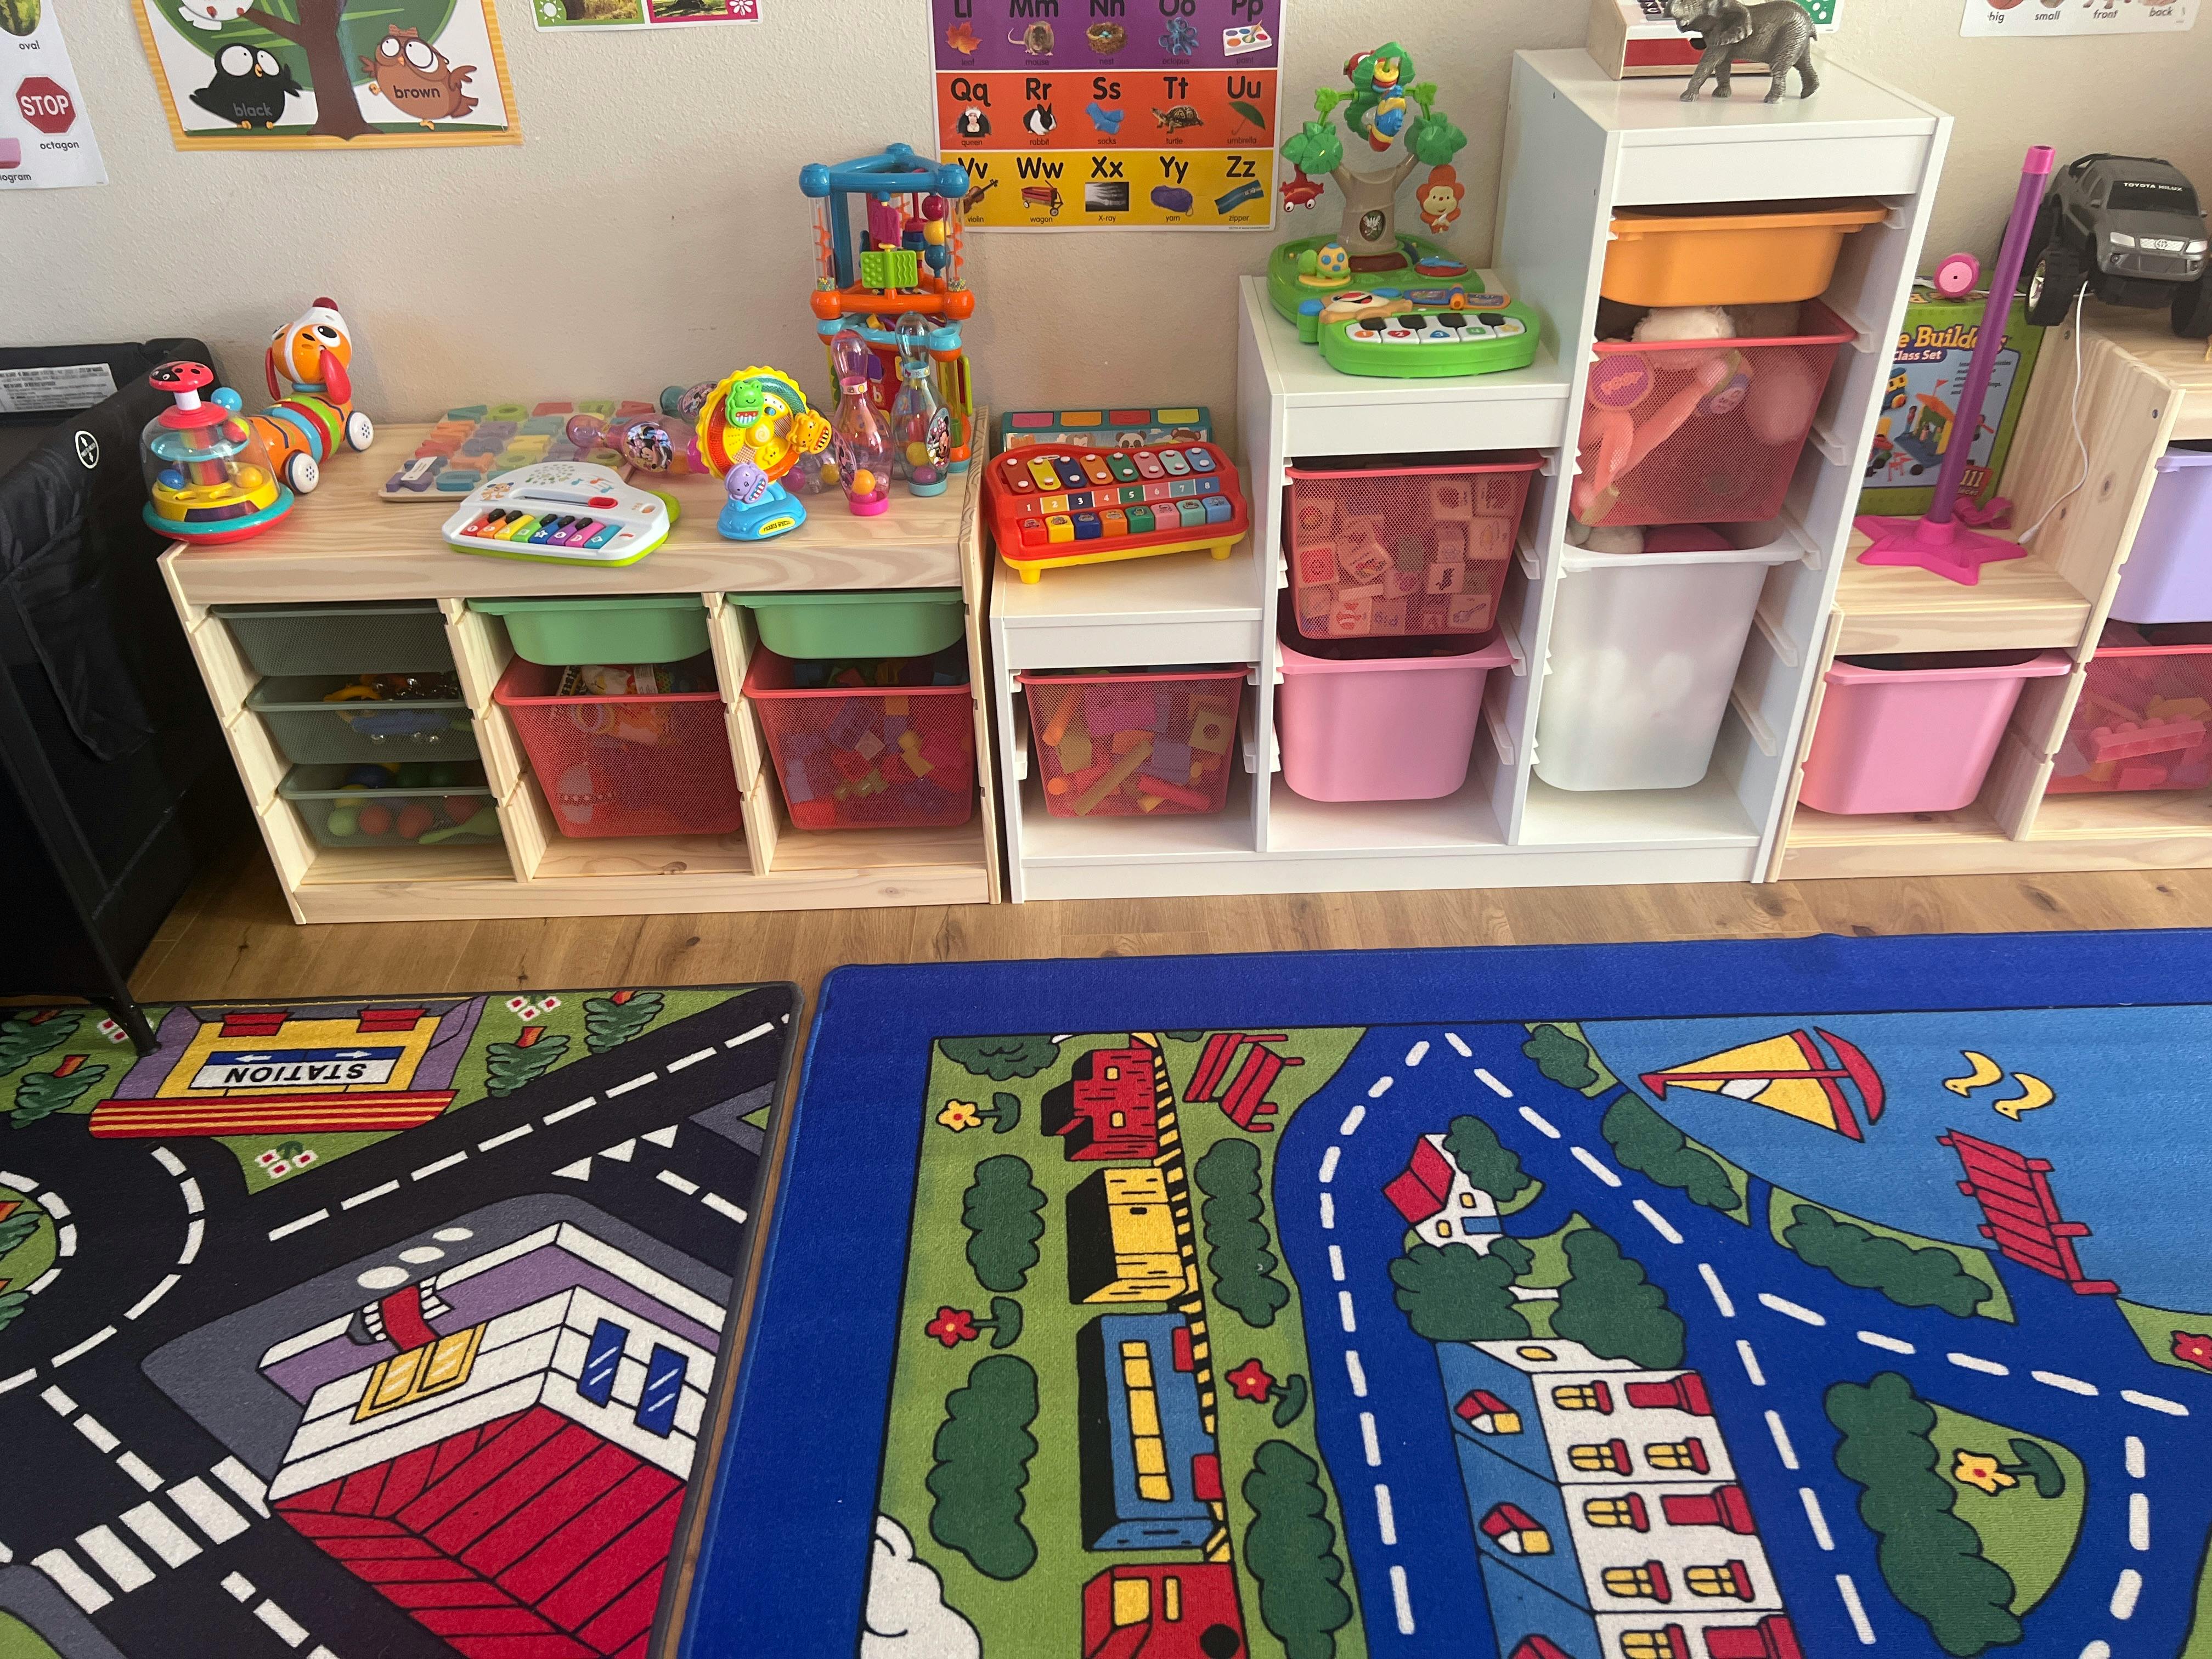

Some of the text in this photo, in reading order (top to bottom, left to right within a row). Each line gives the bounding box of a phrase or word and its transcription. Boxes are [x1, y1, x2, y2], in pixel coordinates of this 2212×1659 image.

[1988, 11, 2005, 23] big
[2034, 10, 2060, 20] small
[2092, 9, 2119, 19] front
[2149, 7, 2174, 18] back
[19, 40, 41, 50] oval
[1162, 58, 1189, 66] octopus
[1236, 57, 1254, 65] paint
[394, 84, 441, 99] brown
[951, 77, 991, 107] Qq
[1026, 78, 1052, 100] Rr
[1093, 77, 1121, 99] Ss
[1163, 76, 1188, 99] Tt
[1227, 76, 1261, 99] Uu
[20, 95, 69, 117] STOP
[233, 102, 273, 117] black
[40, 141, 80, 151] octagon
[958, 157, 988, 179] Vv
[1017, 157, 1064, 179] Ww
[1091, 156, 1123, 178] Xx
[1159, 156, 1188, 184] Yy
[1226, 156, 1256, 178] Zz
[1921, 349, 1943, 360] Set
[224, 1063, 368, 1084] STATION
